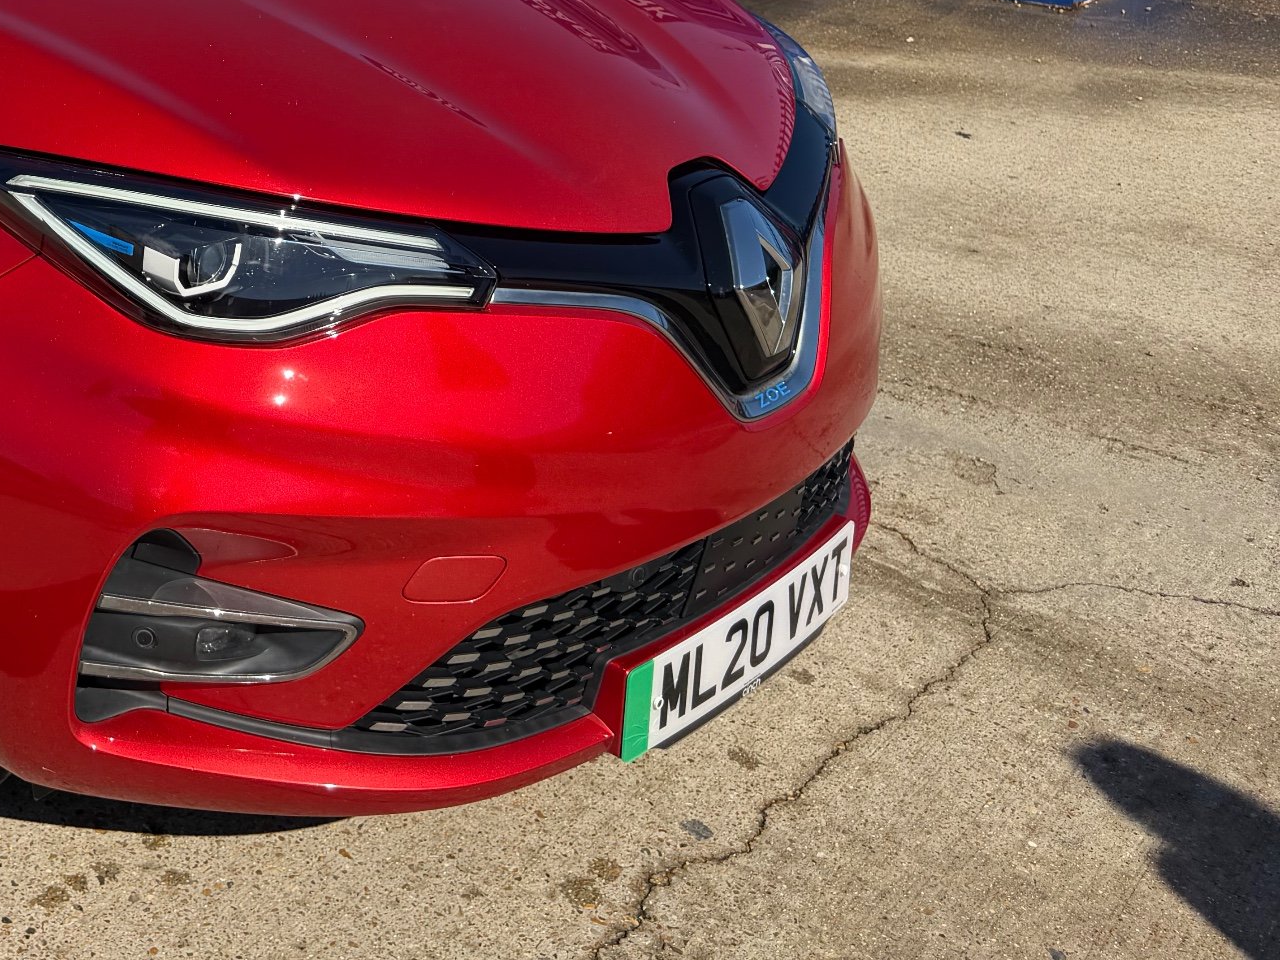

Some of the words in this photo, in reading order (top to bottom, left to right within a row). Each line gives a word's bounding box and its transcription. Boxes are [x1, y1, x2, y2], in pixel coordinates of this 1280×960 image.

[754, 381, 791, 408] ZOE
[659, 599, 775, 730] ML20
[788, 536, 848, 640] VXT
